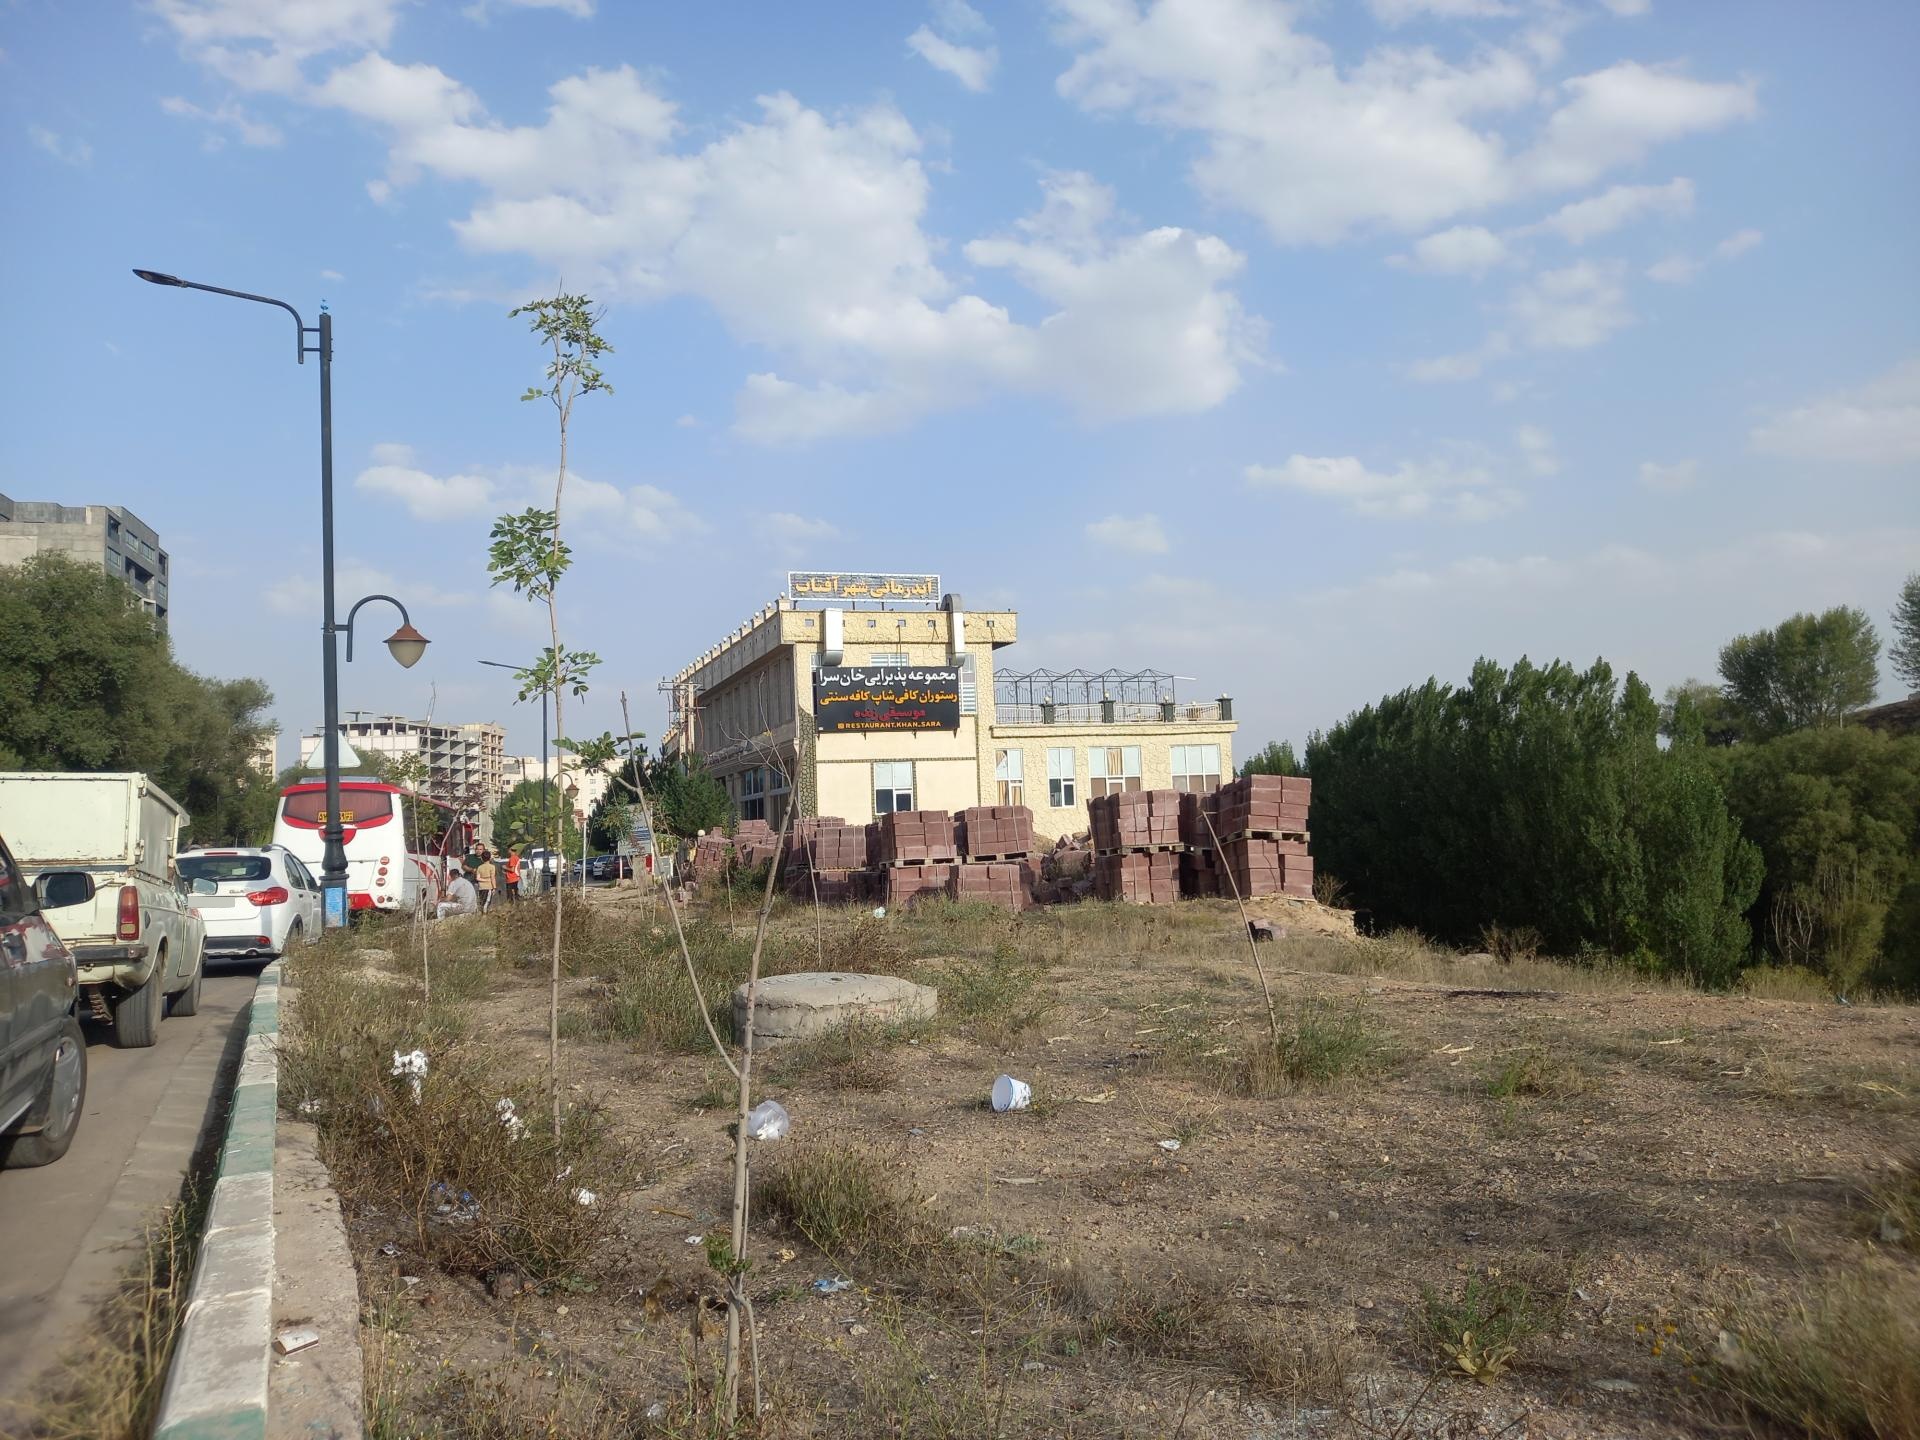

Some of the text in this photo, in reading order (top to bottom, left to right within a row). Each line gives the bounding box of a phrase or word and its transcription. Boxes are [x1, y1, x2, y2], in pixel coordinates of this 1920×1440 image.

[795, 575, 839, 596] آفتاب
[842, 579, 869, 598] شهر
[819, 667, 957, 687] مجموعه پذیرایی خان سرا
[819, 689, 958, 706] رستوران کافی شاپ کافه سنتی
[854, 707, 880, 721] زنده
